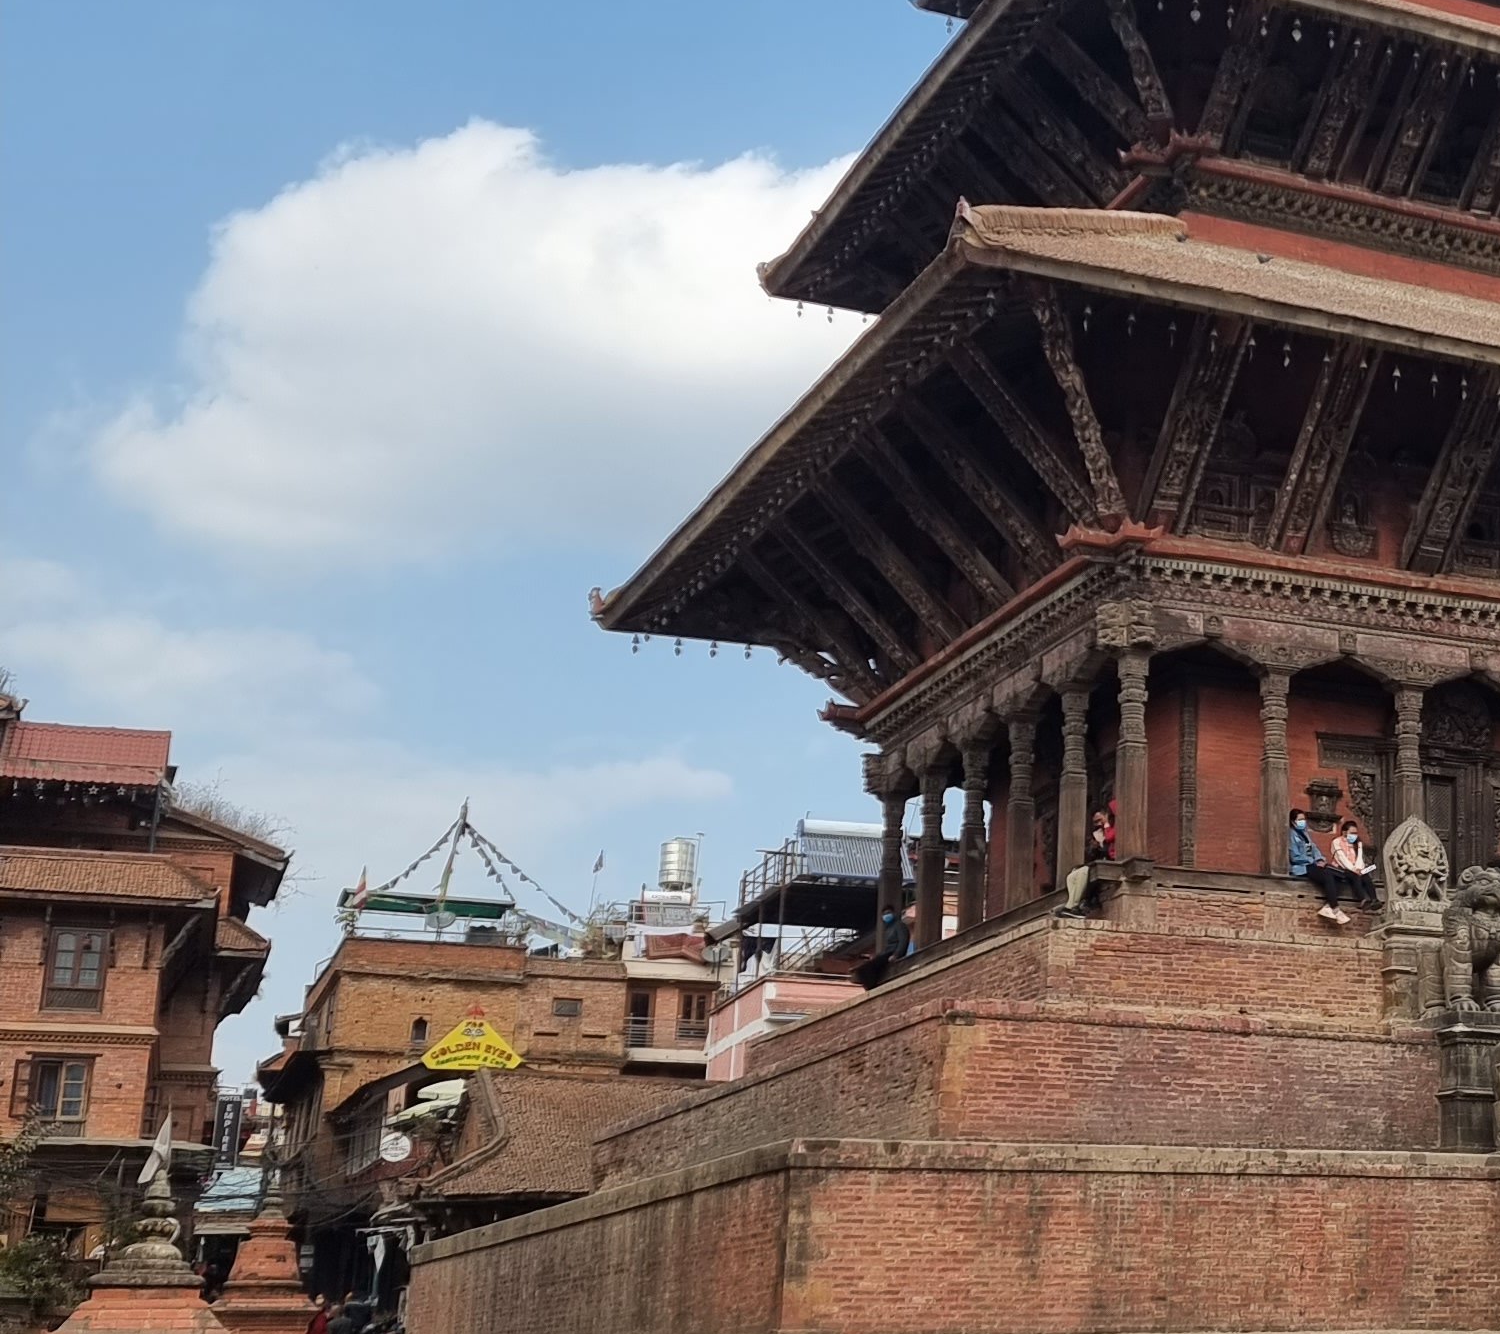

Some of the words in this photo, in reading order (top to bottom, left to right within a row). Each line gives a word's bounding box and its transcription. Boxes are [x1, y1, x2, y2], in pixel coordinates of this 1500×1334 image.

[430, 1041, 481, 1059] GOLDEN
[484, 1044, 513, 1062] EYES
[219, 1094, 242, 1102] HOTEL
[221, 1103, 234, 1152] EMPIRE
